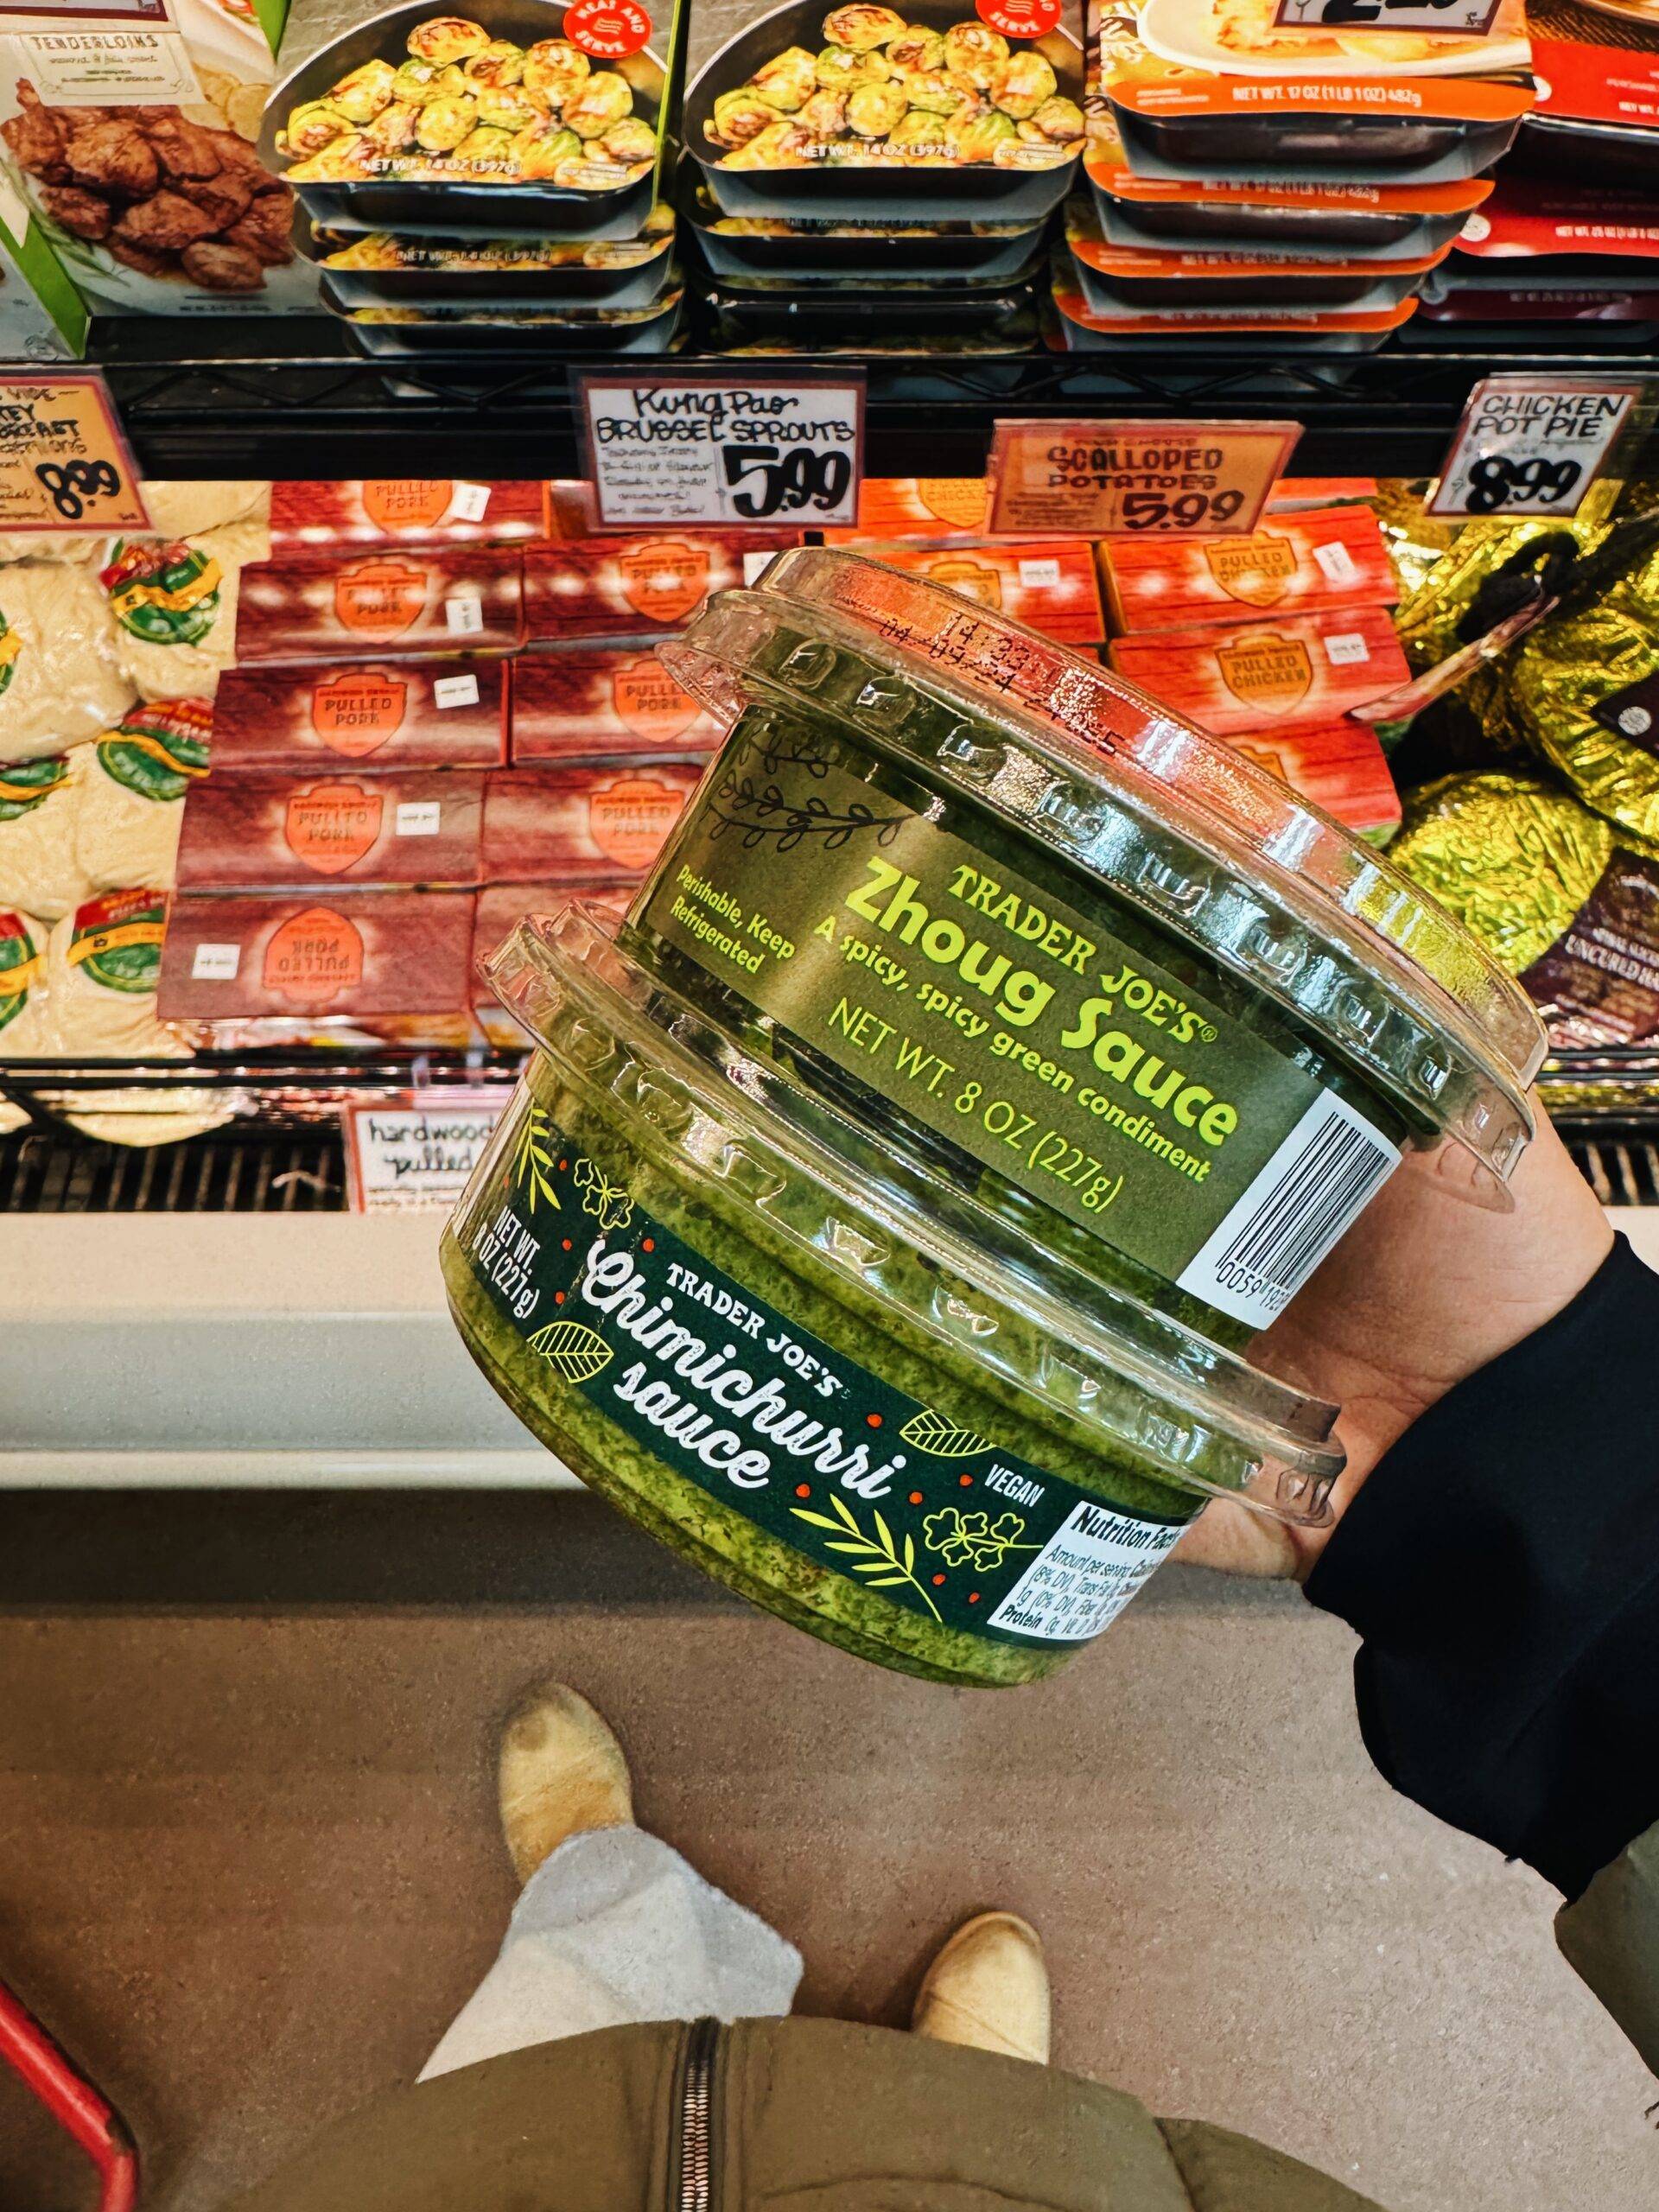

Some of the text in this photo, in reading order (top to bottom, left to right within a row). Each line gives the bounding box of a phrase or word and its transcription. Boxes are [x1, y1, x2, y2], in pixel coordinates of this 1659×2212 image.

[29, 35, 159, 50] TENDERLOINS
[575, 30, 626, 53] SERVE
[1233, 87, 1258, 100] NET
[360, 159, 391, 171] NET
[796, 145, 826, 158] NET
[632, 387, 798, 421] Kung Pao
[1483, 395, 1625, 416] CHICKEN
[596, 417, 855, 443] BRUSSEL SPROUTS
[1471, 416, 1604, 438] POT PIE
[1047, 445, 1224, 472] SCALLOPED
[723, 444, 850, 518] 5.99
[1047, 474, 1217, 491] POTATOES
[1465, 456, 1582, 514] 8.99
[1123, 490, 1245, 530] 5.99
[1220, 551, 1283, 570] PULLED
[1231, 654, 1298, 674] PULLED
[1233, 669, 1306, 690] CHICKEN
[325, 696, 392, 712] PULLED
[335, 712, 379, 726] PORK
[677, 864, 795, 960] Perishable, Keep
[948, 864, 1097, 976] TRADER
[671, 895, 766, 975] Refrigerated
[844, 856, 1238, 1147] Zhoug Sauce
[814, 915, 1211, 1183] A spicy, spicy green condiment
[828, 996, 1123, 1213] NET WT. 8 OZ (227g)
[369, 1114, 494, 1142] hardwood
[384, 1145, 474, 1179] pulled
[493, 1205, 541, 1275] NET WT.
[479, 1231, 501, 1270] OZ
[491, 1251, 541, 1319] (227g)
[665, 1262, 766, 1339] TRADER
[582, 1239, 906, 1500] Chimichurri
[613, 1362, 771, 1489] sauce
[984, 1463, 1046, 1508] VEGAN
[1071, 1505, 1153, 1550] Nutrition
[1045, 1544, 1092, 1573] Amount
[998, 1604, 1044, 1630] Protein
